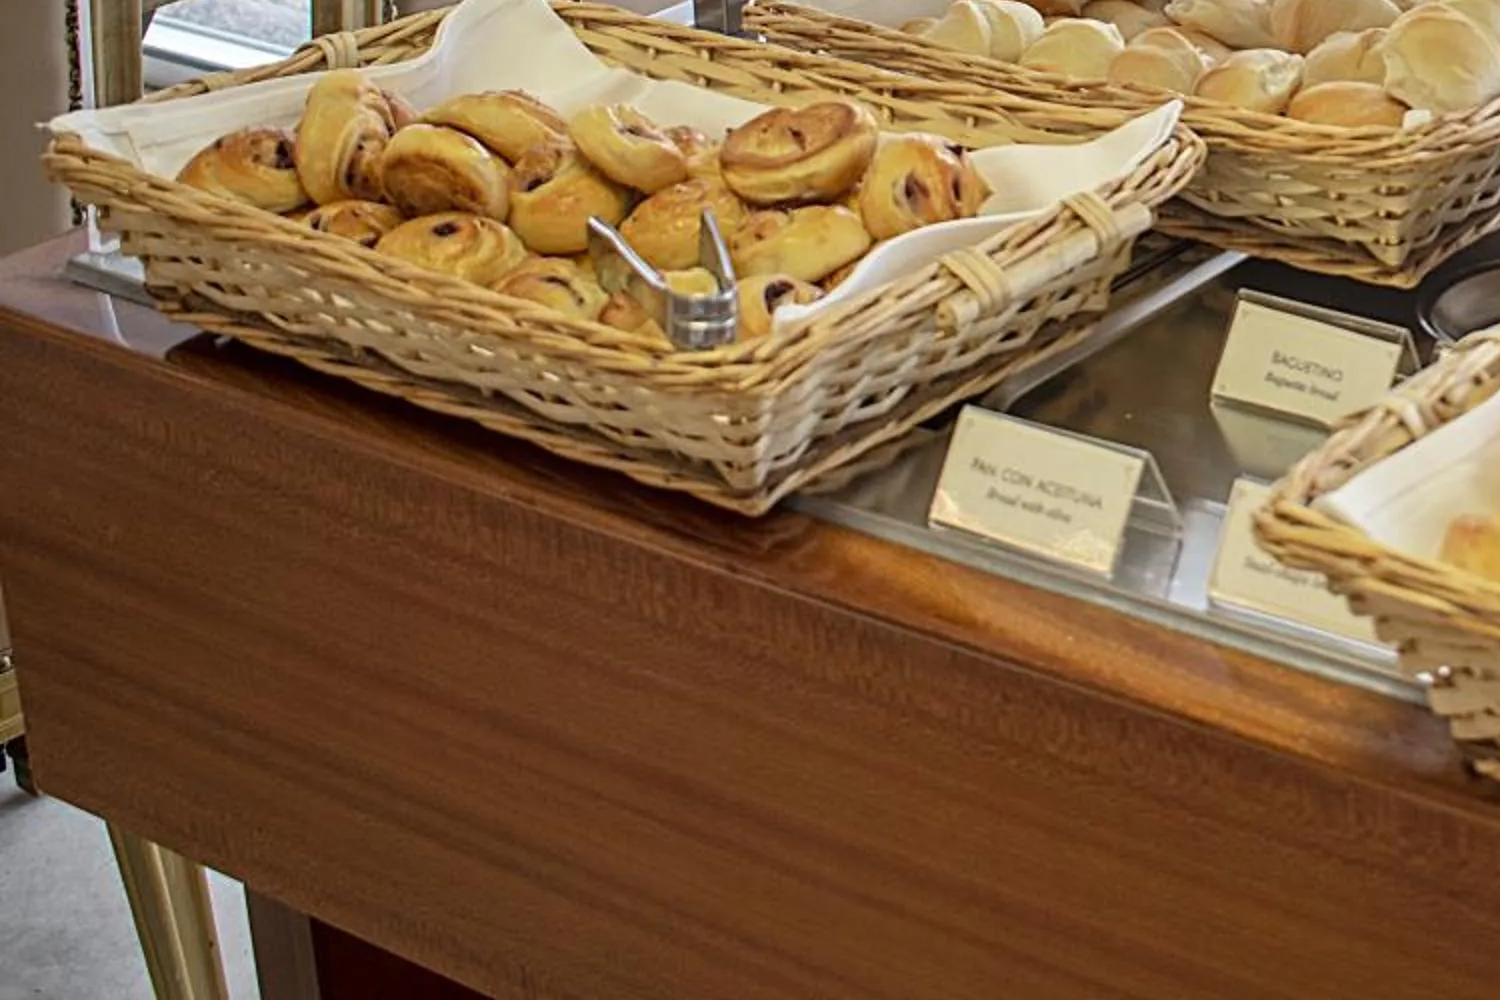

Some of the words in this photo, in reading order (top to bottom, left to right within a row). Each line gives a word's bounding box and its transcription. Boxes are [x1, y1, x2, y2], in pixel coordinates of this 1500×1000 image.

[971, 457, 997, 477] PAN
[1001, 468, 1033, 487] CON
[1037, 479, 1103, 510] ACEITUNA
